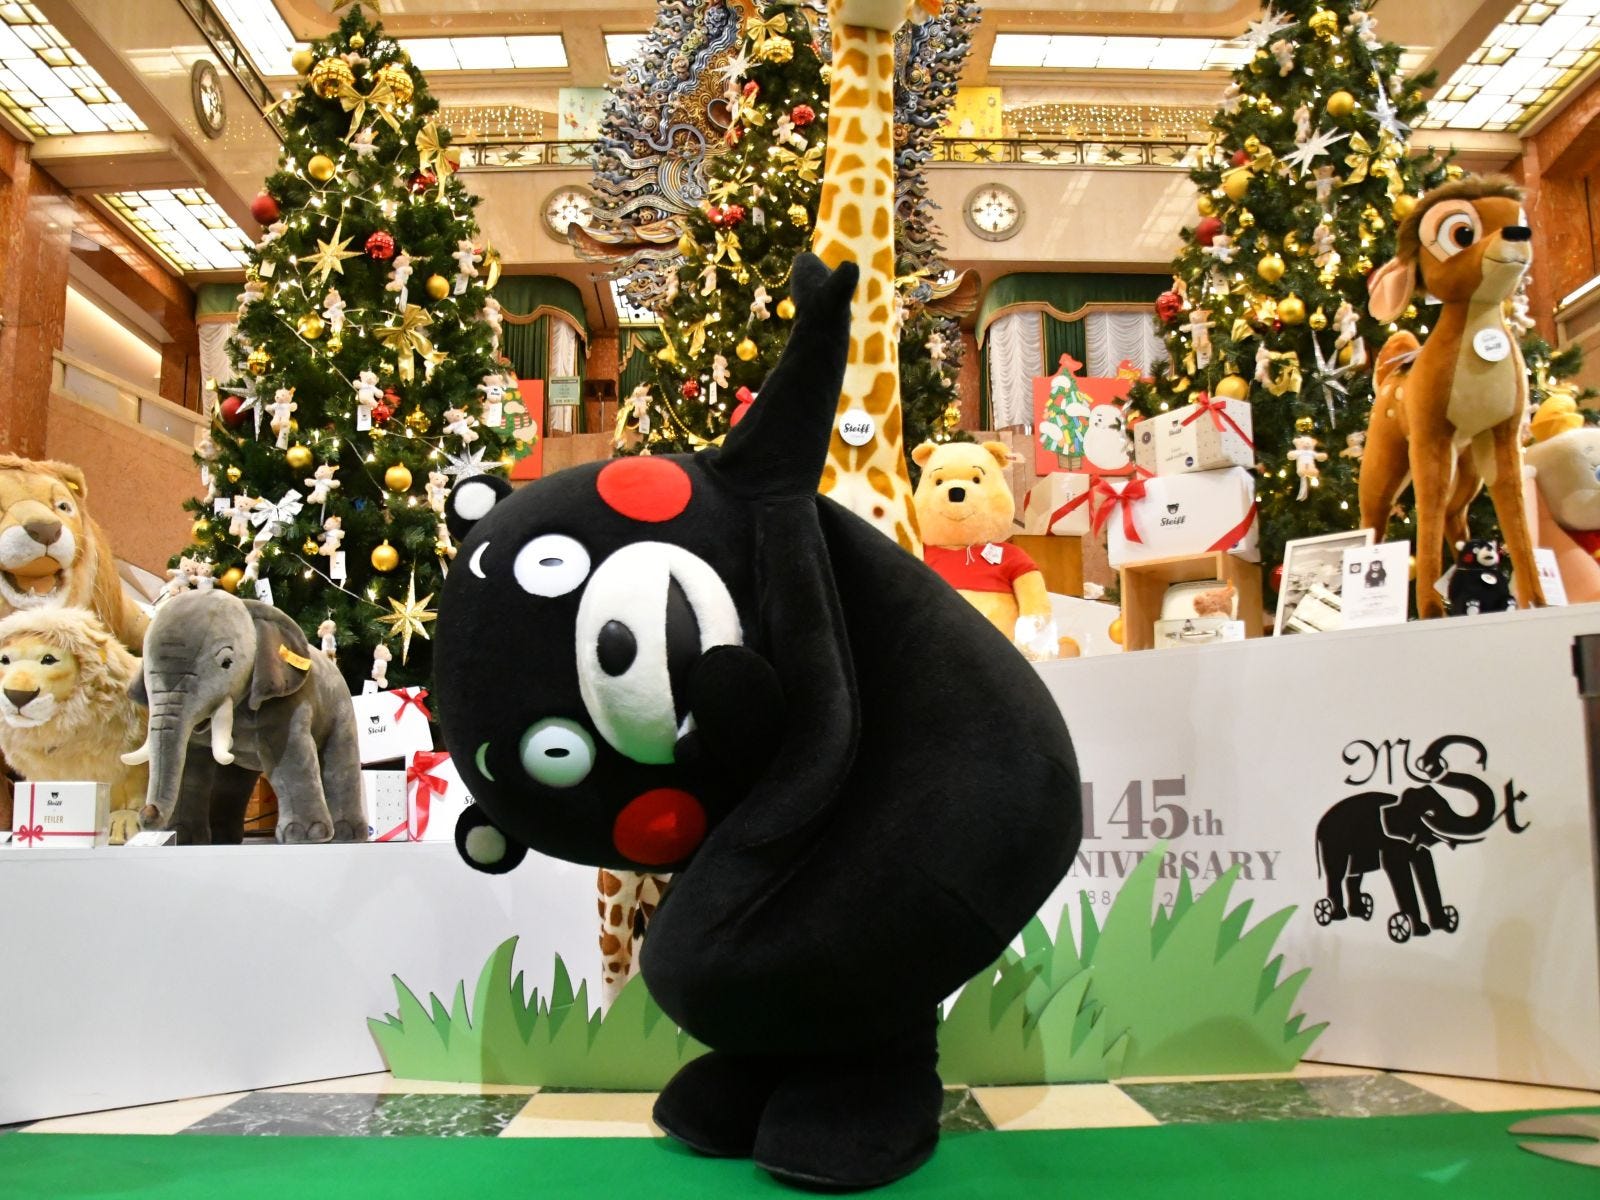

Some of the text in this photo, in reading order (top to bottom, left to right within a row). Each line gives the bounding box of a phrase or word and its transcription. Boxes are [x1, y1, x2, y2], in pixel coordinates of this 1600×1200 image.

[843, 422, 871, 435] Steiff
[1160, 515, 1186, 527] Steiff
[367, 725, 387, 735] Steiff
[44, 815, 64, 824] FEILER
